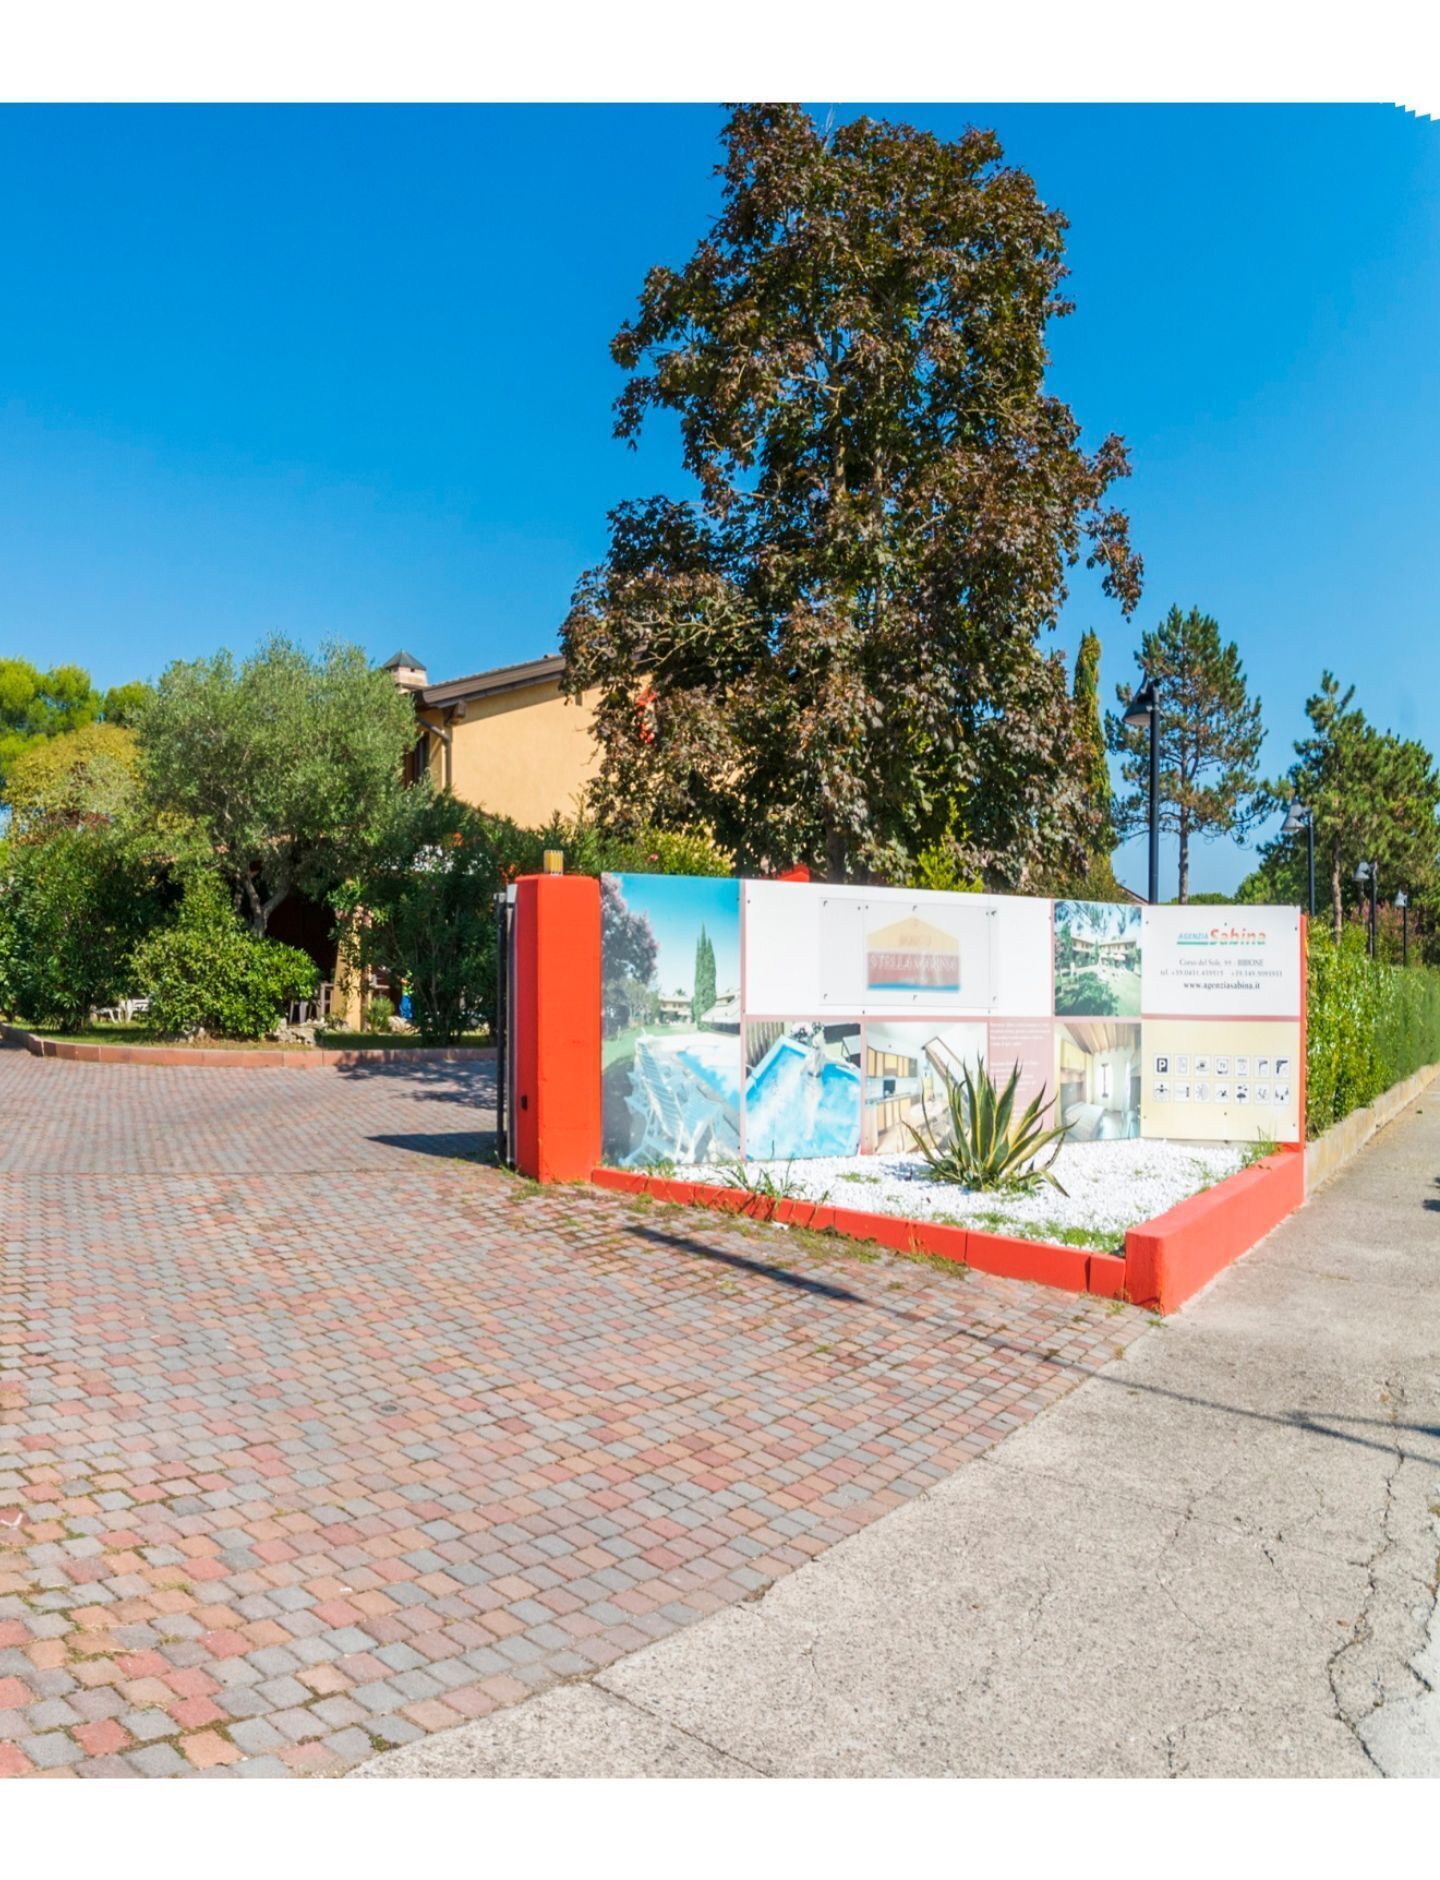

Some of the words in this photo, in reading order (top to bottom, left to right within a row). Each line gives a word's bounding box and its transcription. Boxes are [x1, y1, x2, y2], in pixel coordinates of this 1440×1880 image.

[1178, 932, 1209, 940] AGENZIA
[1210, 927, 1266, 946] Sabina
[1183, 980, 1260, 990] www.agenziasabina.it
